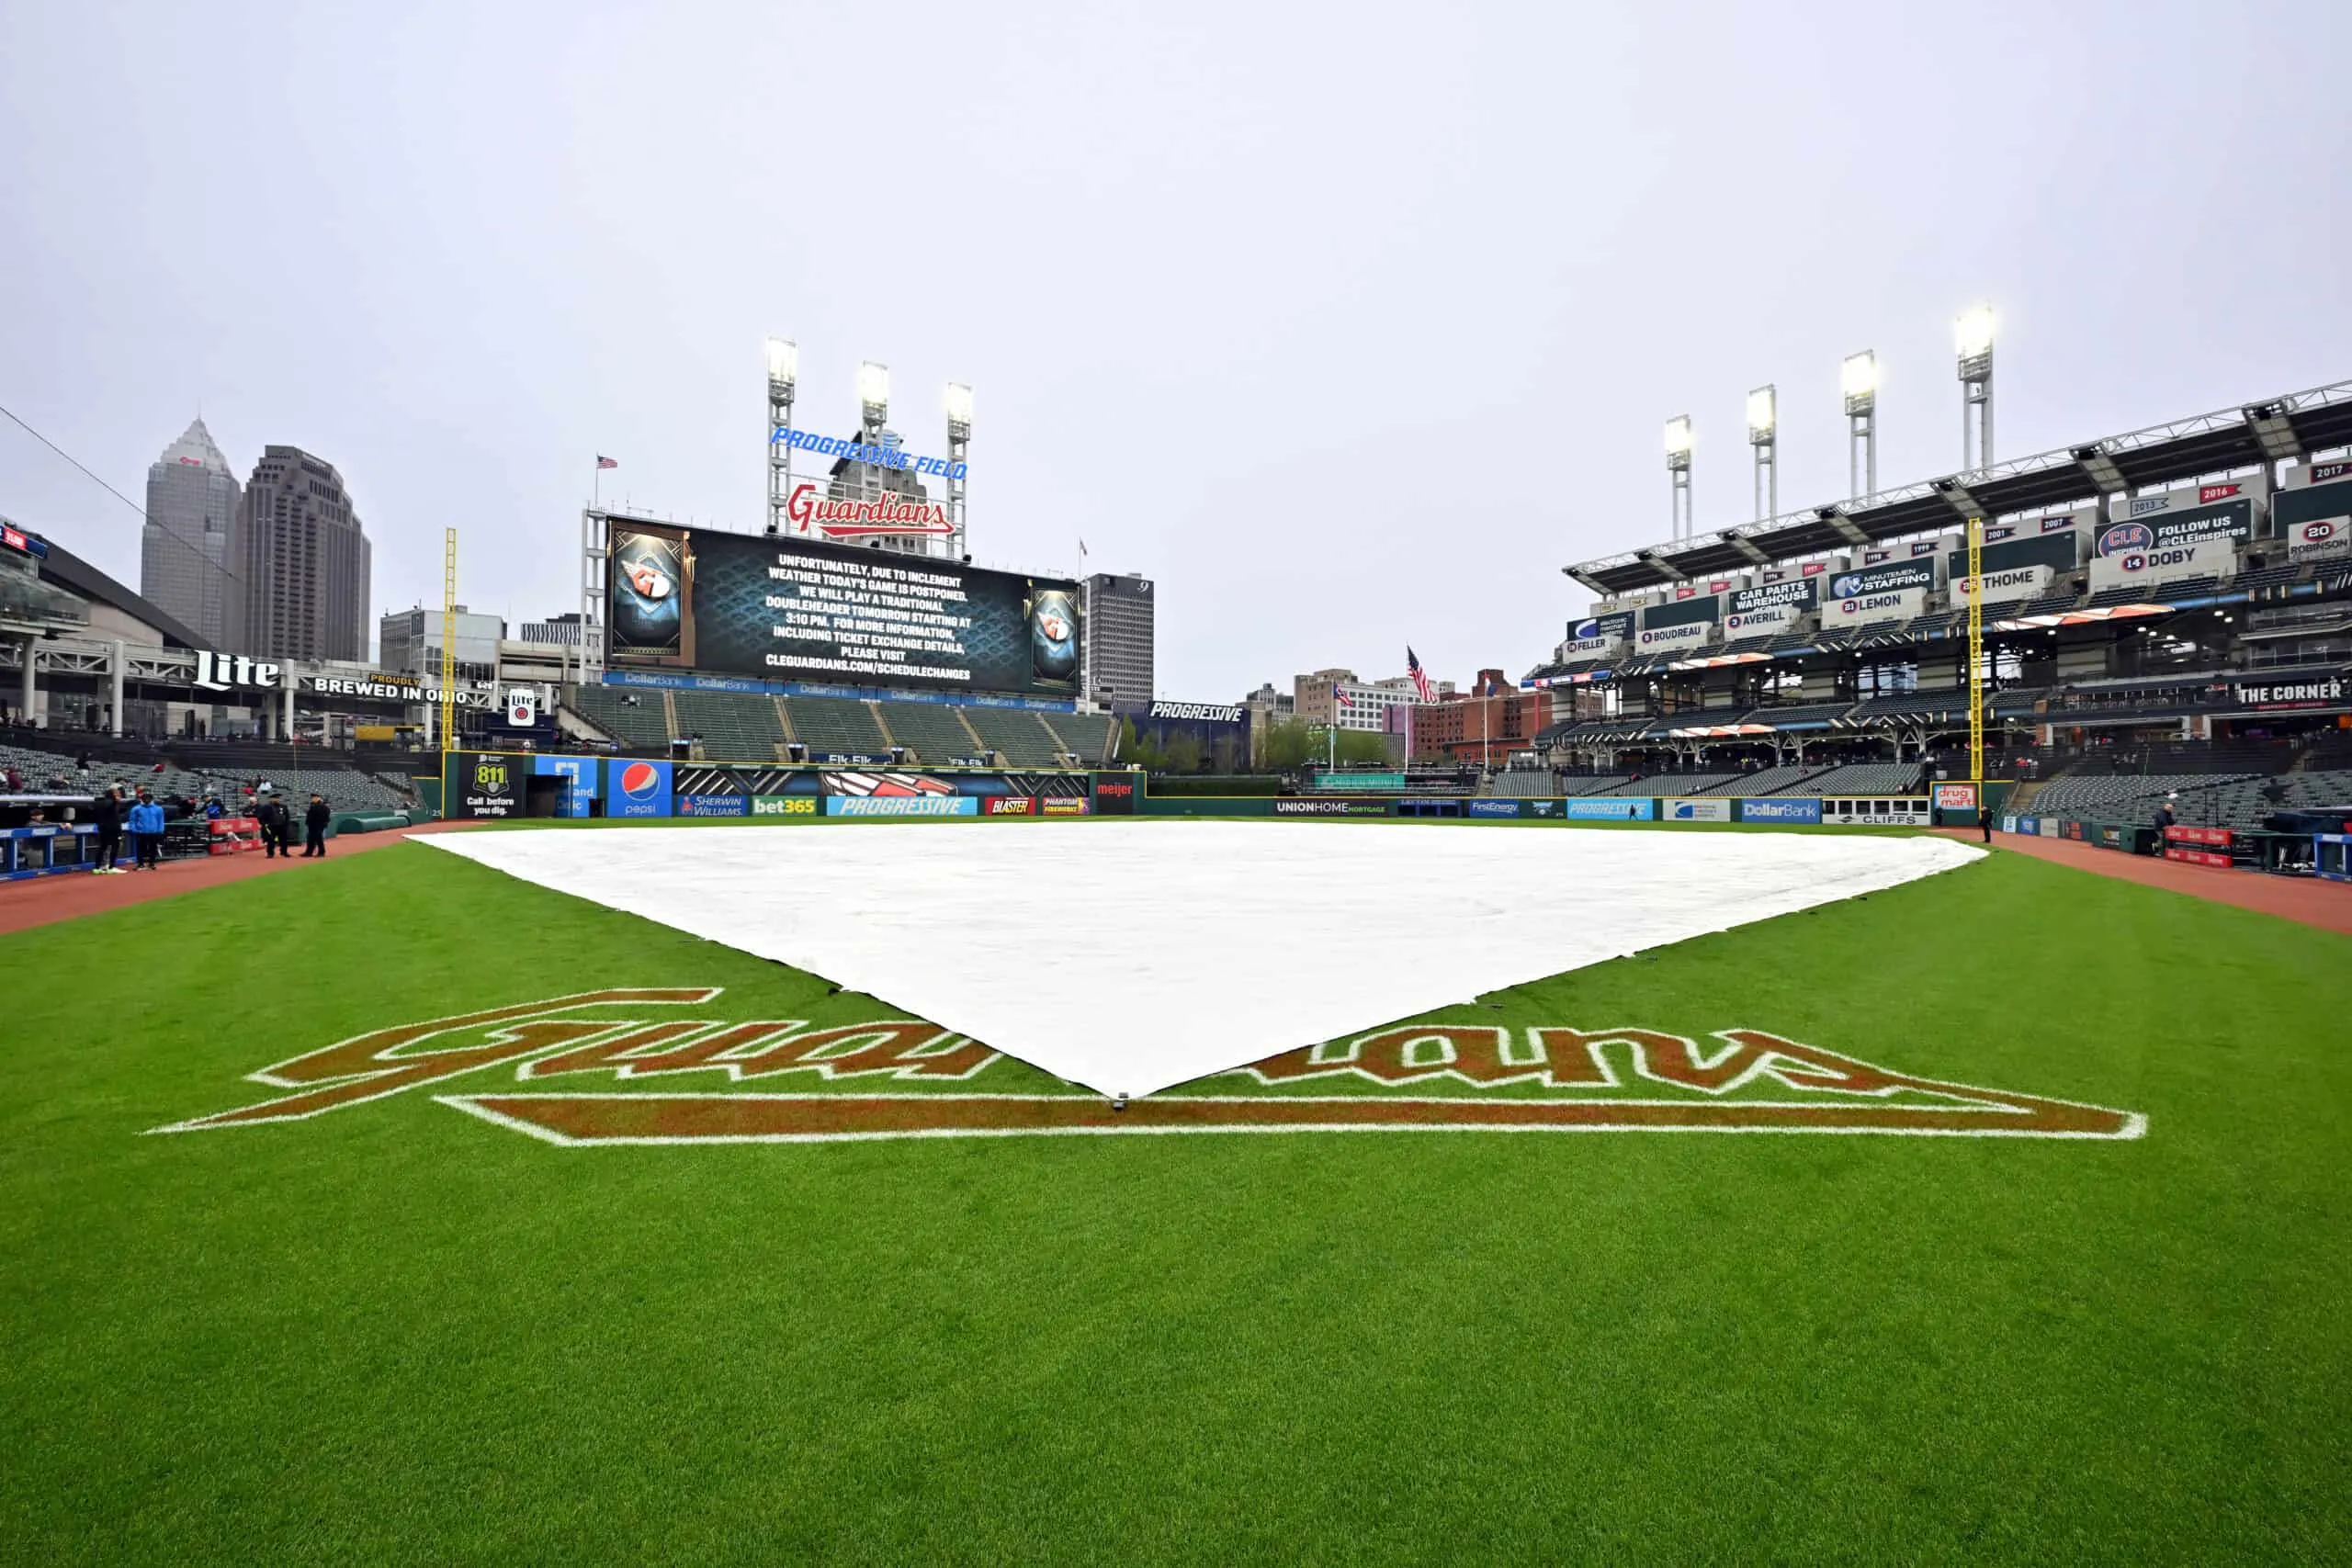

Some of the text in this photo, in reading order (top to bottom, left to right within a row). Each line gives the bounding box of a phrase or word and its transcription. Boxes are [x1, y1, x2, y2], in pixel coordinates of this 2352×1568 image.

[771, 426, 968, 480] PROGRESSIVE FIELD
[2316, 465, 2343, 478] 2017
[2205, 488, 2228, 499] 2016
[787, 483, 956, 537] Guardians
[2134, 501, 2155, 513] 2013
[2044, 518, 2063, 529] 2007
[2158, 516, 2231, 537] FOLLOW US
[2307, 525, 2330, 537] 20
[1987, 529, 2006, 540] 2001
[2108, 527, 2143, 547] CLE
[2158, 526, 2247, 547] @CLEinspires
[2290, 538, 2348, 554] ROBINSON
[2126, 547, 2196, 569] 14 DOBY
[778, 554, 962, 588] UNFORTUNATELY, DUE TO INCLEMENT
[1863, 569, 1917, 581] MINUTEMEN
[768, 567, 968, 603] WEATHER TODAY'S GAME IS POSTPONED.
[1864, 572, 1930, 591] STAFFING
[1983, 570, 2034, 589] THOME
[798, 585, 944, 612] WE WILL PLAY A TRADITIONAL
[1739, 581, 1806, 601] CAR PARTS
[1736, 590, 1809, 611] WAREHOUSE
[1859, 594, 1901, 611] LEMON
[765, 595, 971, 628] DOUBLEHEADER TOMORROW STARTING AT
[1743, 611, 1785, 626] AVERILL
[786, 612, 956, 641] 3:10 PM. FOR MORE INFORMATION,
[1654, 626, 1701, 641] BOUDREAU
[773, 625, 966, 655] INCLUDING TICKET EXCHANGE DETAILS,
[1577, 638, 1605, 652] FELLER
[841, 646, 906, 661] PLEASE VISIT
[192, 649, 279, 691] Lite
[765, 653, 970, 680] CLEGUARDIANS.COM/SCHEDULECHANGES
[370, 674, 420, 686] PROUDLY
[314, 678, 398, 698] BREWED
[402, 686, 421, 700] IN
[2241, 682, 2342, 704] THE CORNER
[511, 694, 533, 706] Lite
[1150, 702, 1243, 722] PROGRESSIVE
[477, 765, 504, 784] 811
[1097, 783, 1133, 797] meijer
[1939, 790, 1968, 800] drug
[467, 796, 514, 806] Call before
[695, 796, 742, 807] SHERWIN
[752, 798, 816, 814] bet365
[839, 797, 963, 815] PROGRESSIVE
[992, 800, 1029, 814] BLASTER
[474, 807, 507, 816] you dig.
[625, 803, 656, 816] pepsi
[1744, 804, 1816, 817] DollarBank
[1862, 815, 1917, 825] CLIFFS
